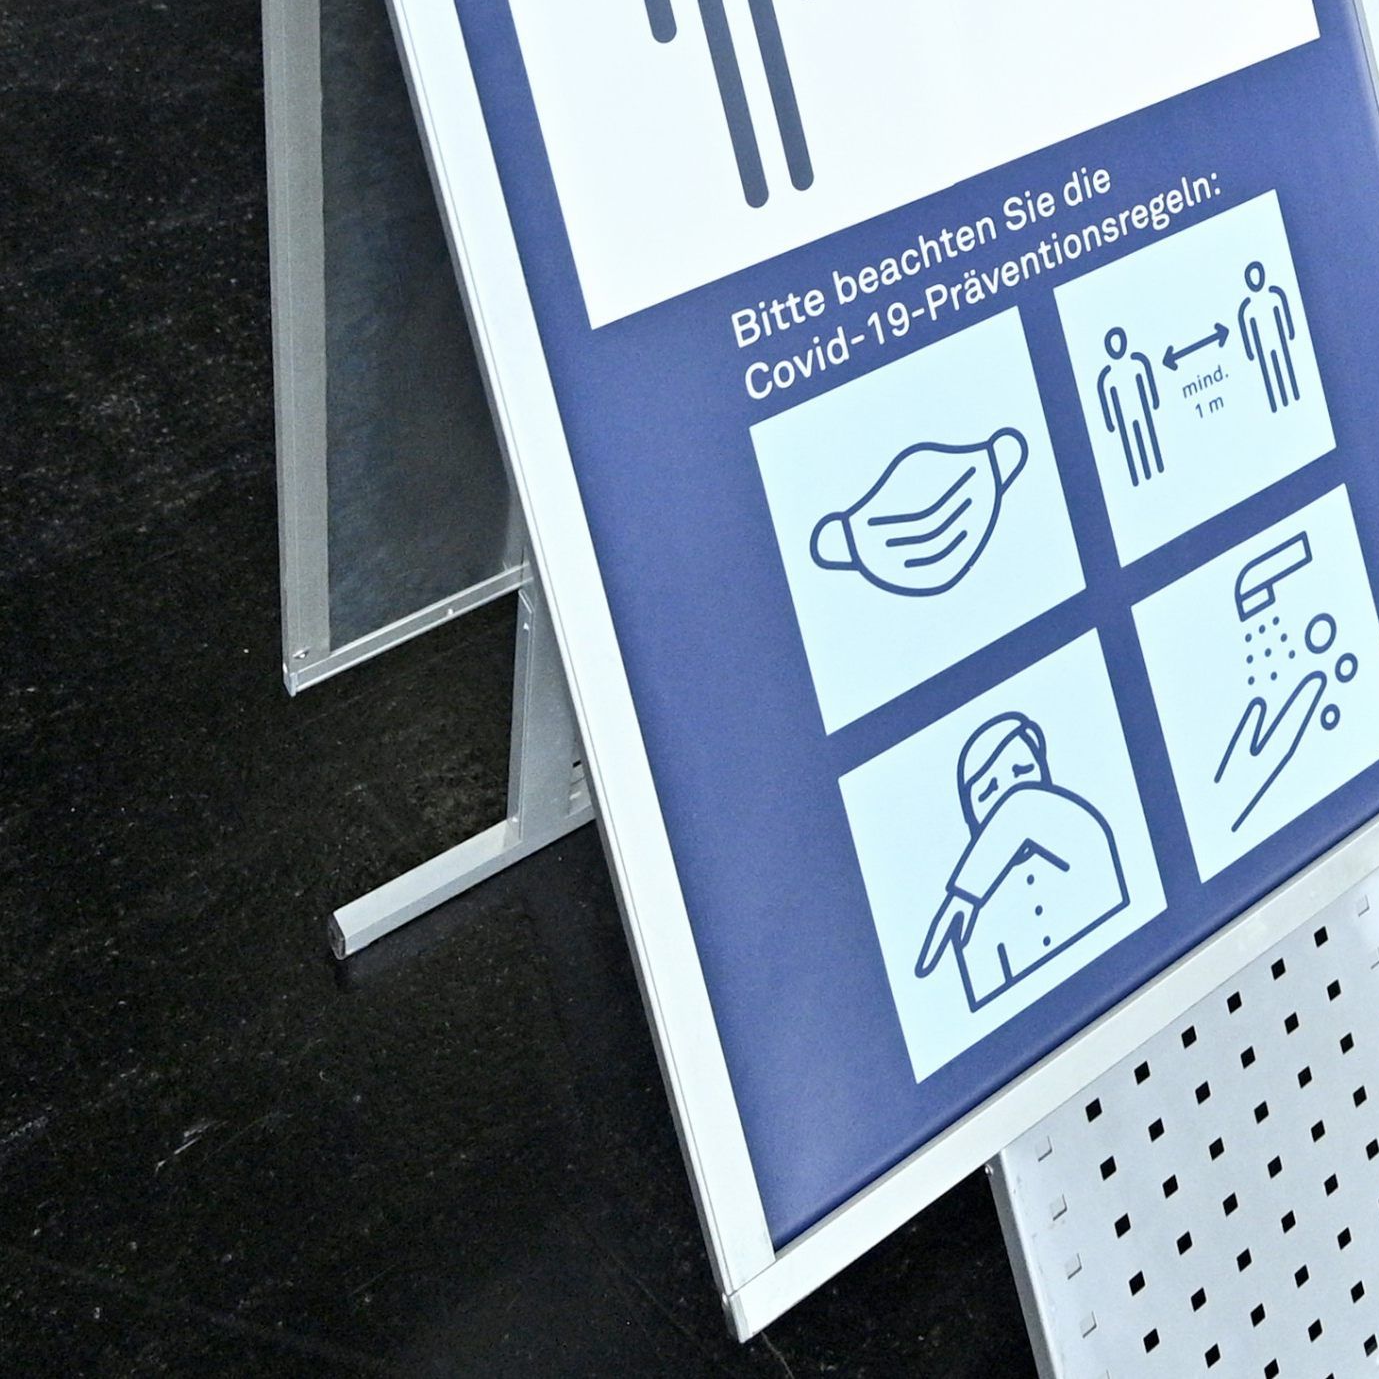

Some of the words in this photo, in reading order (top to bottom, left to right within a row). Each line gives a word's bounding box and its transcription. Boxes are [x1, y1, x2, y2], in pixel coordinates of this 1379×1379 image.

[731, 288, 826, 348] Bitte
[832, 216, 997, 305] beachten
[1003, 190, 1056, 231] Sie
[1063, 167, 1111, 207] die
[745, 172, 1221, 400] Covid-19-Präventionsregeln:
[1181, 364, 1229, 399] mind.
[1195, 402, 1204, 419] 1
[1208, 396, 1225, 414] m
